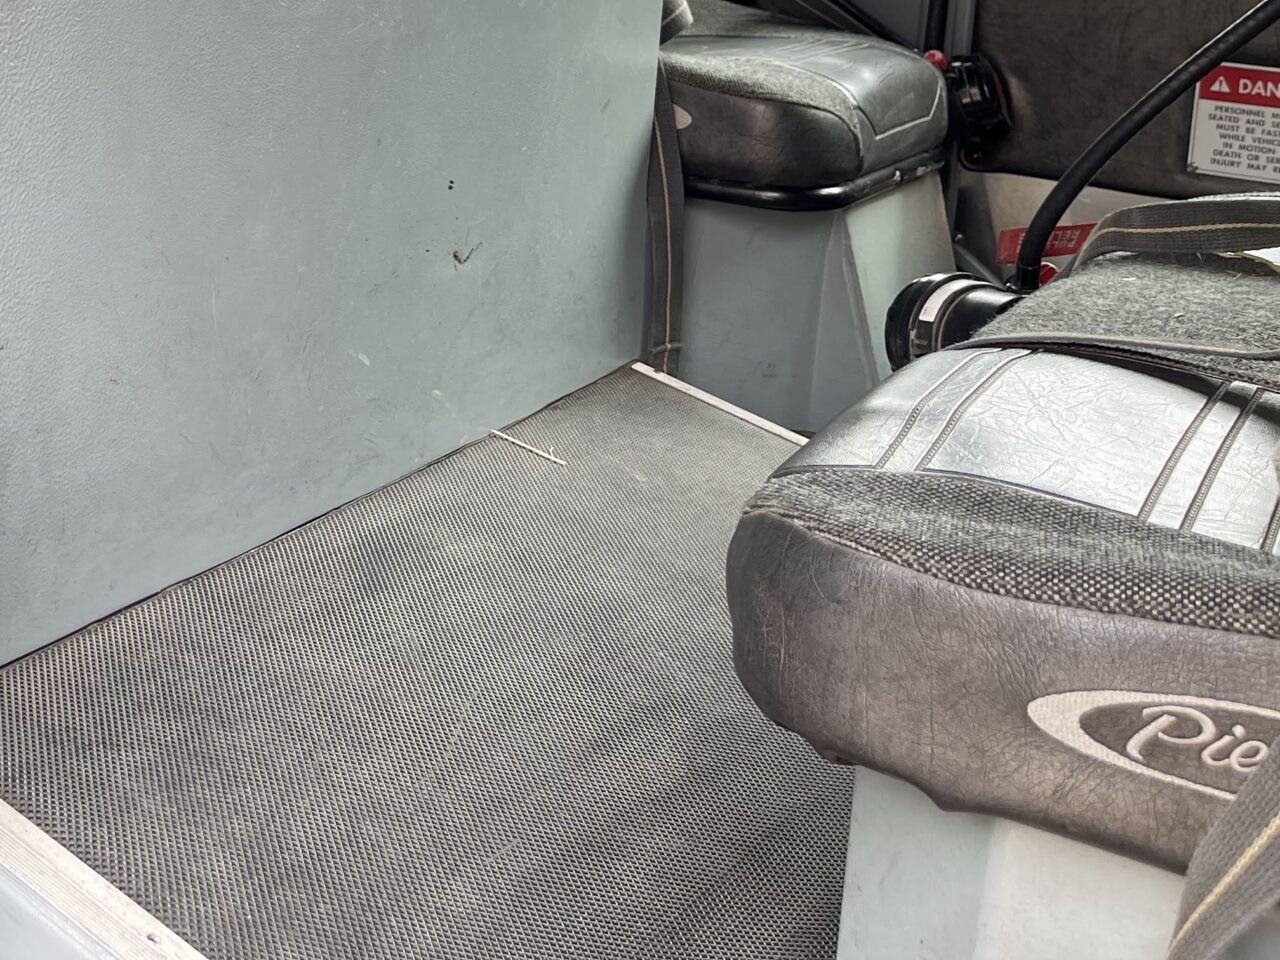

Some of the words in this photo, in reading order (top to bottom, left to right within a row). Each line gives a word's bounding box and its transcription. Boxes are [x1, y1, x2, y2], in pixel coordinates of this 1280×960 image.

[1214, 105, 1265, 118] PERSONNEL
[1208, 113, 1240, 123] SEATED
[1245, 119, 1265, 127] AND
[1216, 123, 1239, 132] MUST
[1219, 132, 1246, 142] WHILE
[1223, 141, 1232, 150] IN
[1239, 145, 1276, 155] MOTION
[1213, 149, 1241, 159] DEATH
[1247, 153, 1260, 161] OR
[1210, 157, 1241, 168] INJURY
[1247, 162, 1267, 171] MAY
